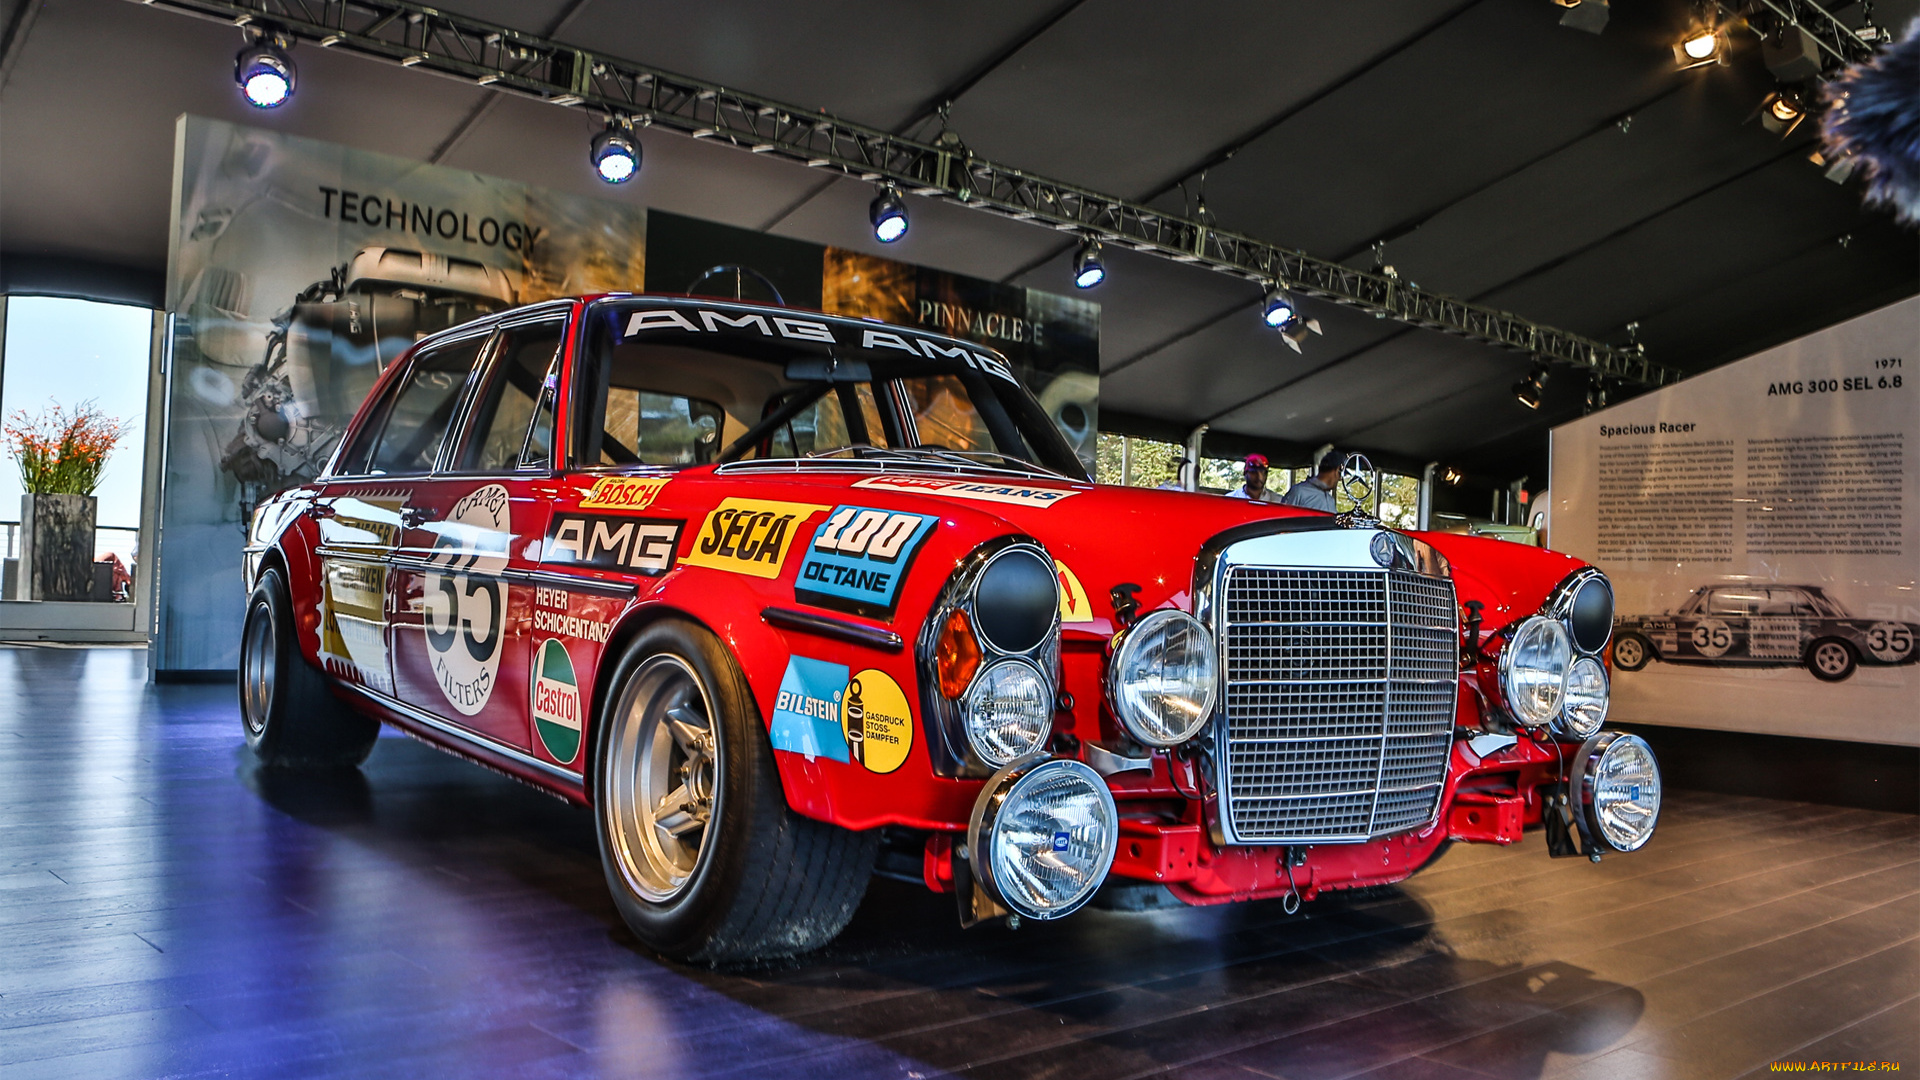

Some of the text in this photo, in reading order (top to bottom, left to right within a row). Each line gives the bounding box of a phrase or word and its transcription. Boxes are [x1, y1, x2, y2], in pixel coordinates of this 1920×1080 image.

[319, 186, 541, 254] TECHNOLOGY
[918, 300, 1023, 342] PINNACLE
[624, 310, 836, 344] AMG
[862, 329, 1020, 388] AMG
[1874, 359, 1902, 369] 1971
[1768, 375, 1903, 396] AMG 300 SEL 6.8
[1600, 421, 1696, 437] Spacious Racer
[456, 487, 506, 528] CAMEL
[593, 484, 660, 505] BOSCH
[952, 483, 1064, 500] JEANS
[547, 519, 678, 569] AMG
[701, 508, 796, 564] SECA
[814, 508, 922, 563] 100
[804, 561, 891, 593] OCTANE
[424, 530, 507, 662] 35
[536, 587, 567, 610] HEYER
[534, 610, 610, 643] SCHICKENTANZ
[1693, 626, 1729, 648] 35
[1868, 629, 1910, 653] 35
[436, 656, 490, 707] FILTERS
[536, 680, 577, 722] Castrol
[776, 691, 838, 723] BILSTEIN
[866, 711, 904, 727] GASDRUCK
[866, 721, 890, 733] STOSS-
